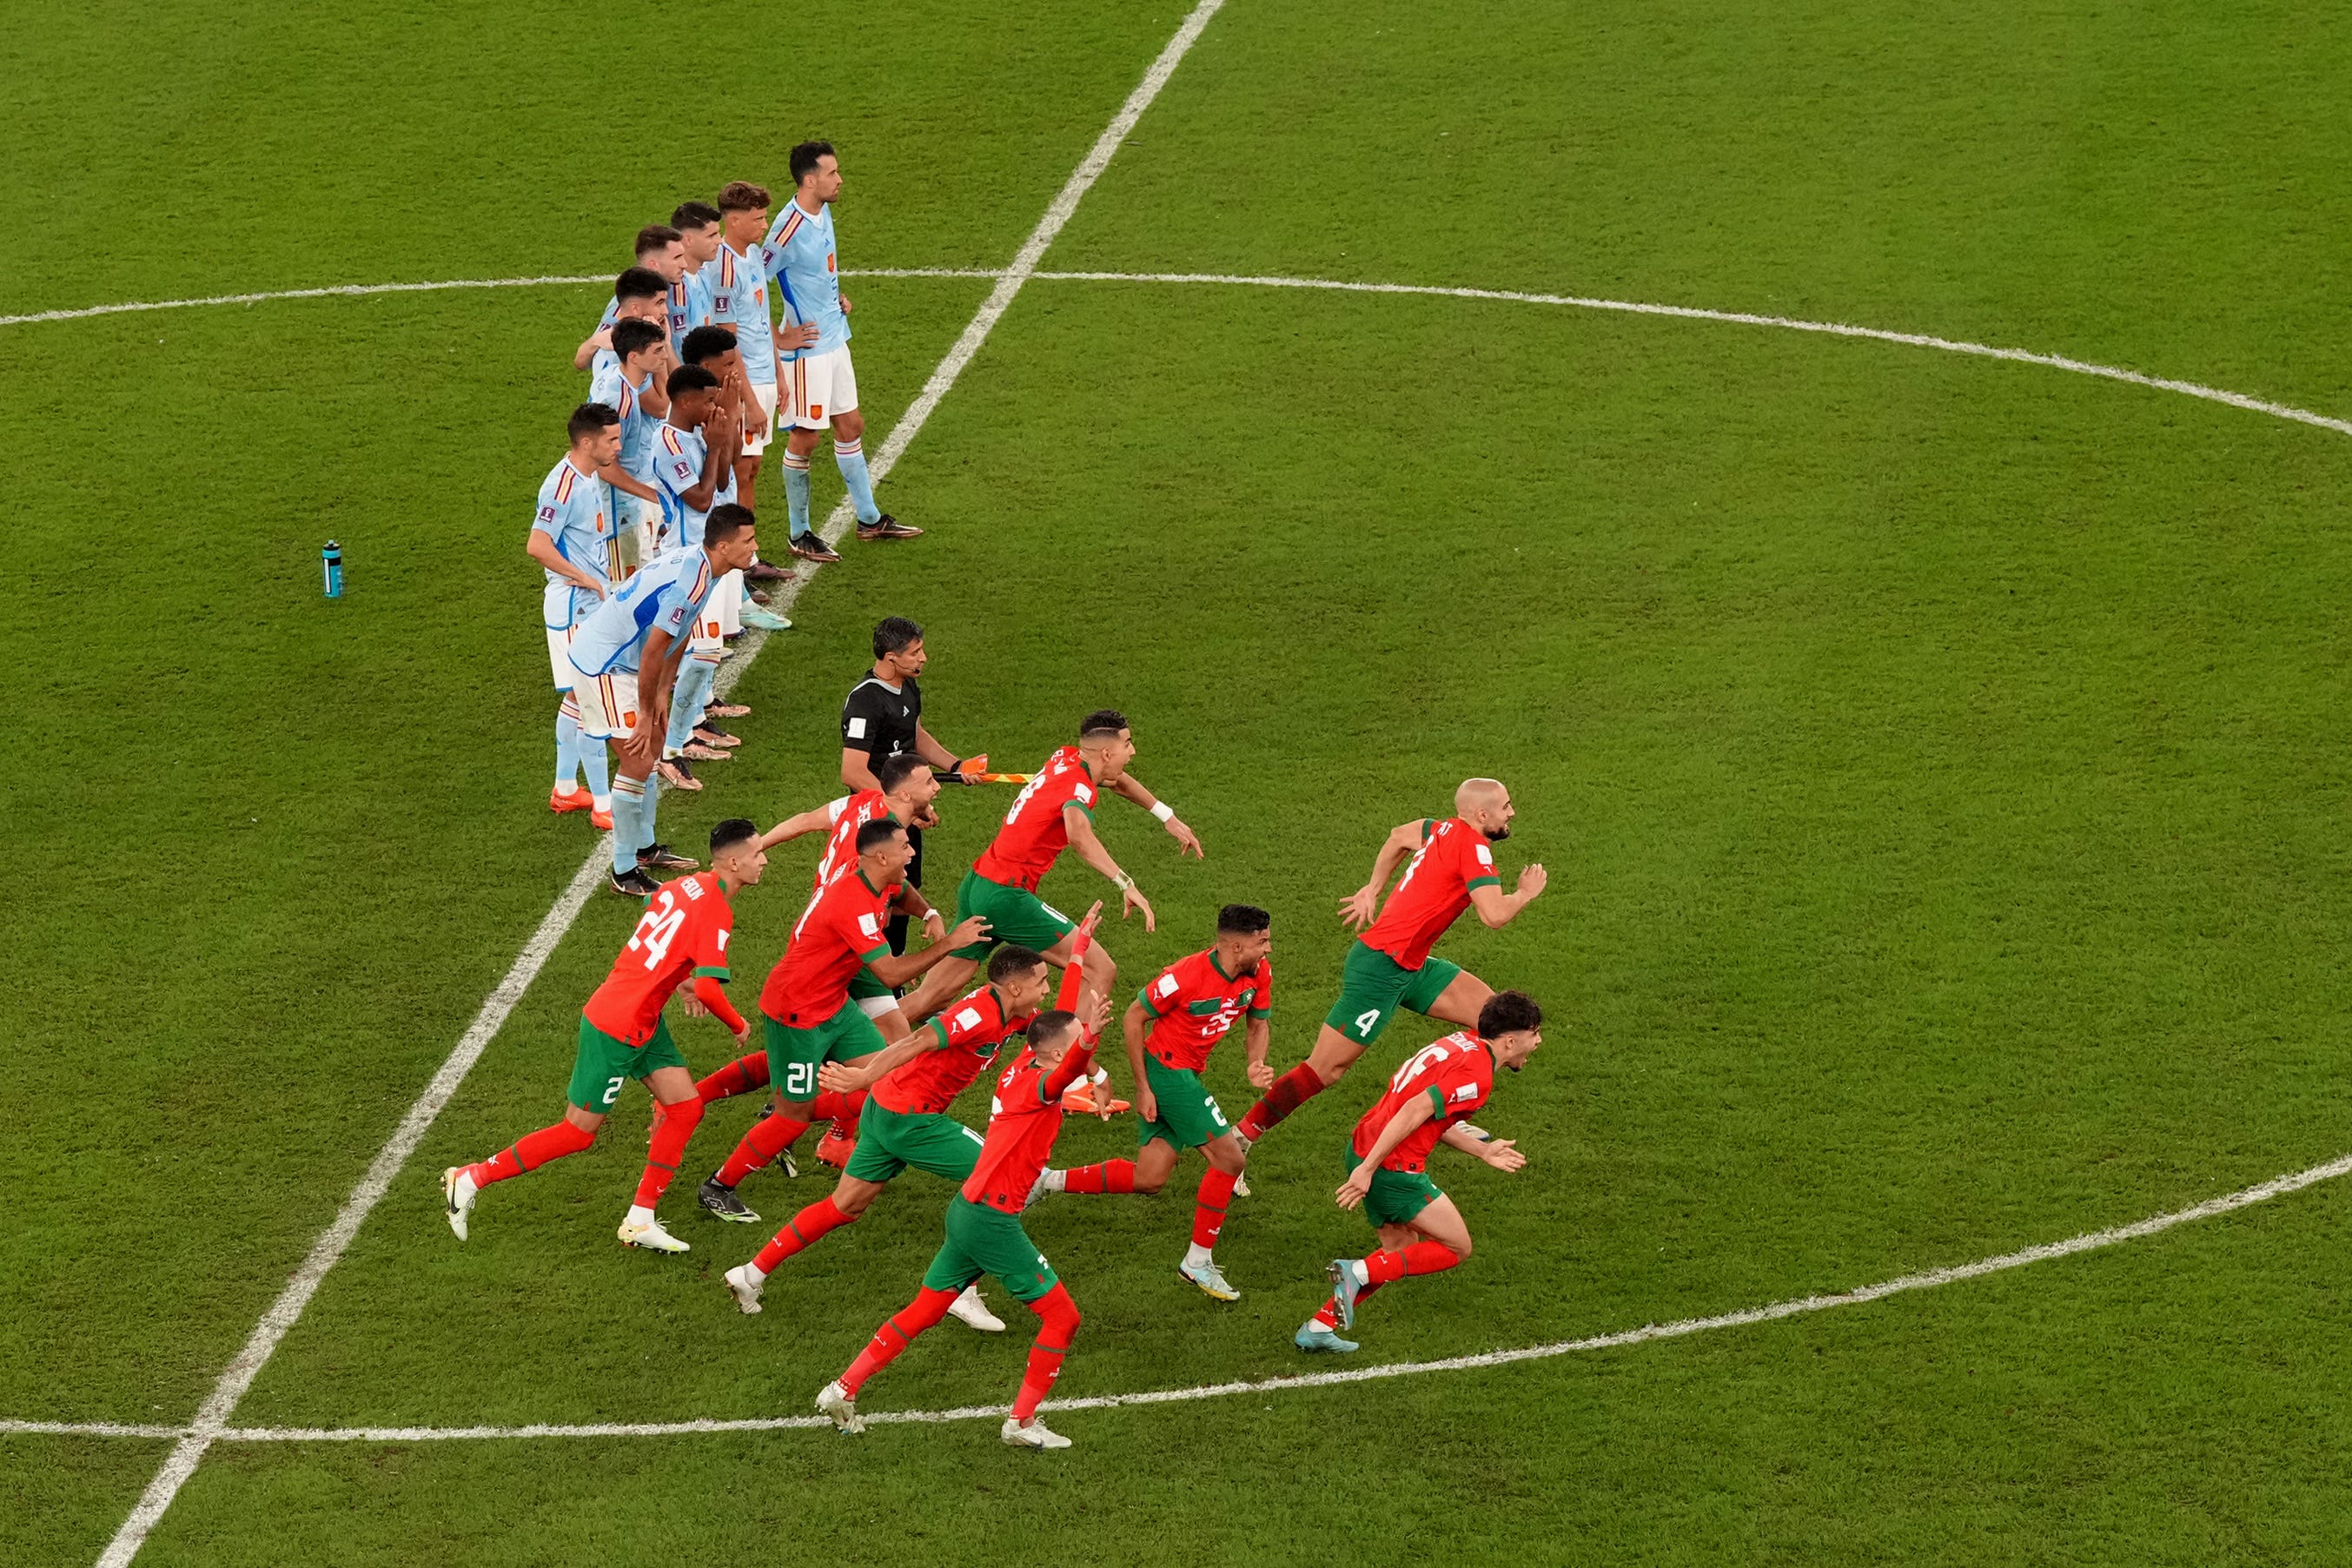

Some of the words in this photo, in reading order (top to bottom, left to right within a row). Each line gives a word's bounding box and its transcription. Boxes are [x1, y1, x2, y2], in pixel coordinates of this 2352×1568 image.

[626, 889, 686, 971] 24
[1202, 1009, 1239, 1037] 25
[1355, 1009, 1381, 1038] 4
[787, 1062, 814, 1095] 21
[1391, 1042, 1450, 1094] 16
[602, 1076, 625, 1105] 2
[1204, 1095, 1228, 1128] 2
